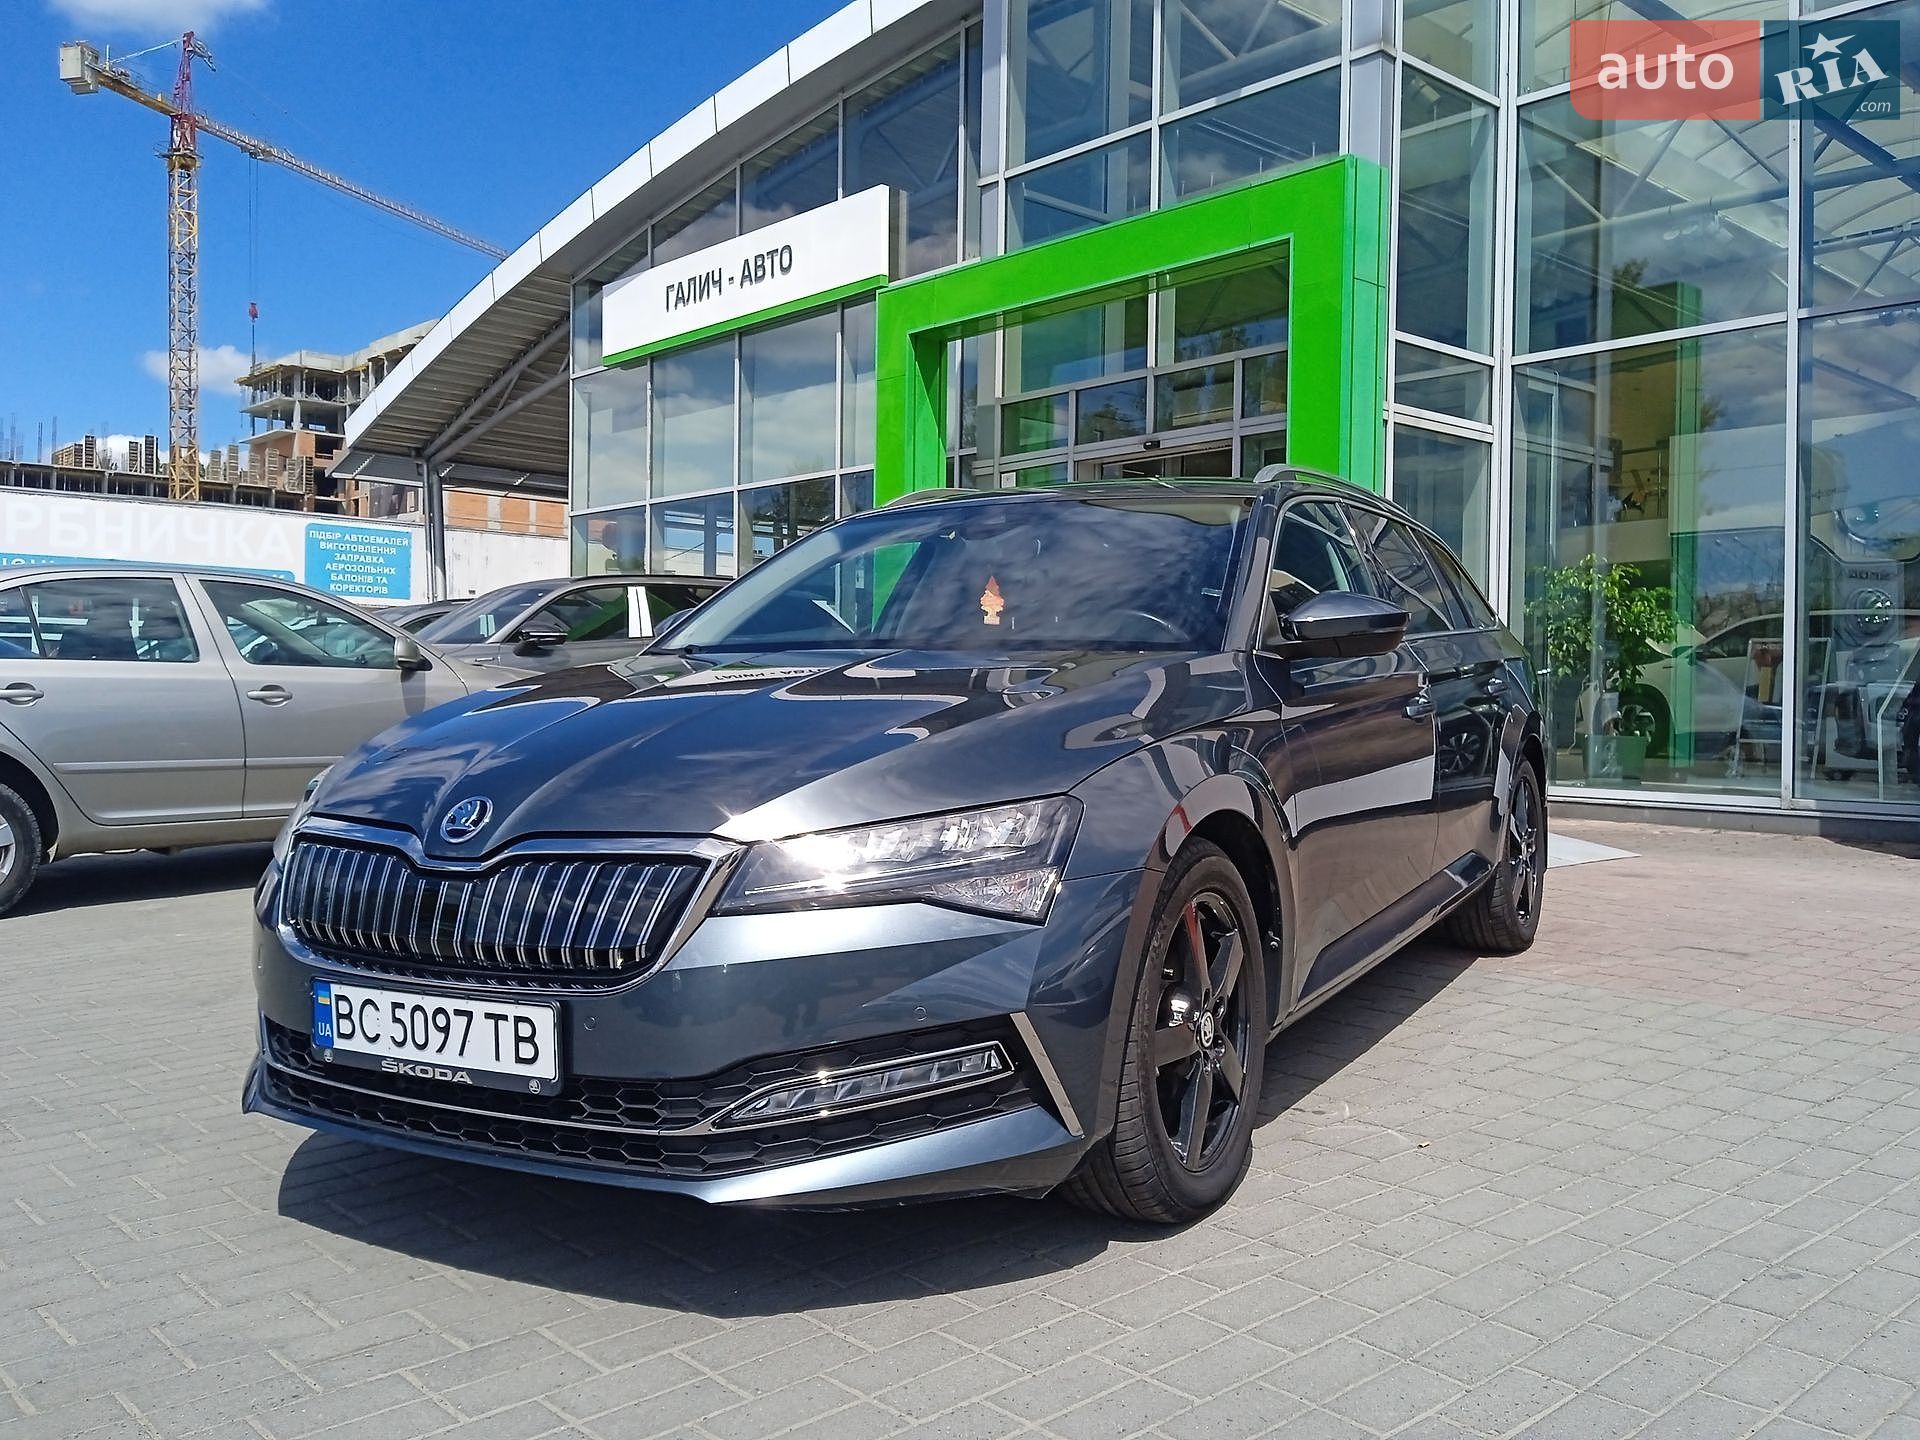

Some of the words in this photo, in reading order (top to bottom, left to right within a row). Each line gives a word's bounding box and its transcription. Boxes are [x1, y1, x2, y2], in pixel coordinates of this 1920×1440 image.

[665, 267, 722, 312] ГАЛИЧ
[739, 244, 793, 289] АВТО
[309, 530, 342, 540] ПІДБІР
[344, 534, 409, 546] АВТОЕМАЛЕЙ
[319, 541, 396, 555] ВИГОТОВЛЕННЯ
[334, 552, 385, 564] ЗАПРАВКА
[325, 562, 396, 575] АЕРОЗОЛЬНИХ
[330, 573, 373, 584] БАЛОНІВ
[376, 576, 388, 585] ТА
[329, 583, 389, 594] КОРЕКТОРІВ
[318, 1022, 332, 1038] UA
[334, 993, 381, 1044] BC
[390, 1002, 474, 1057] 5097
[484, 1012, 539, 1065] TB
[381, 1058, 473, 1085] ŠKODA
